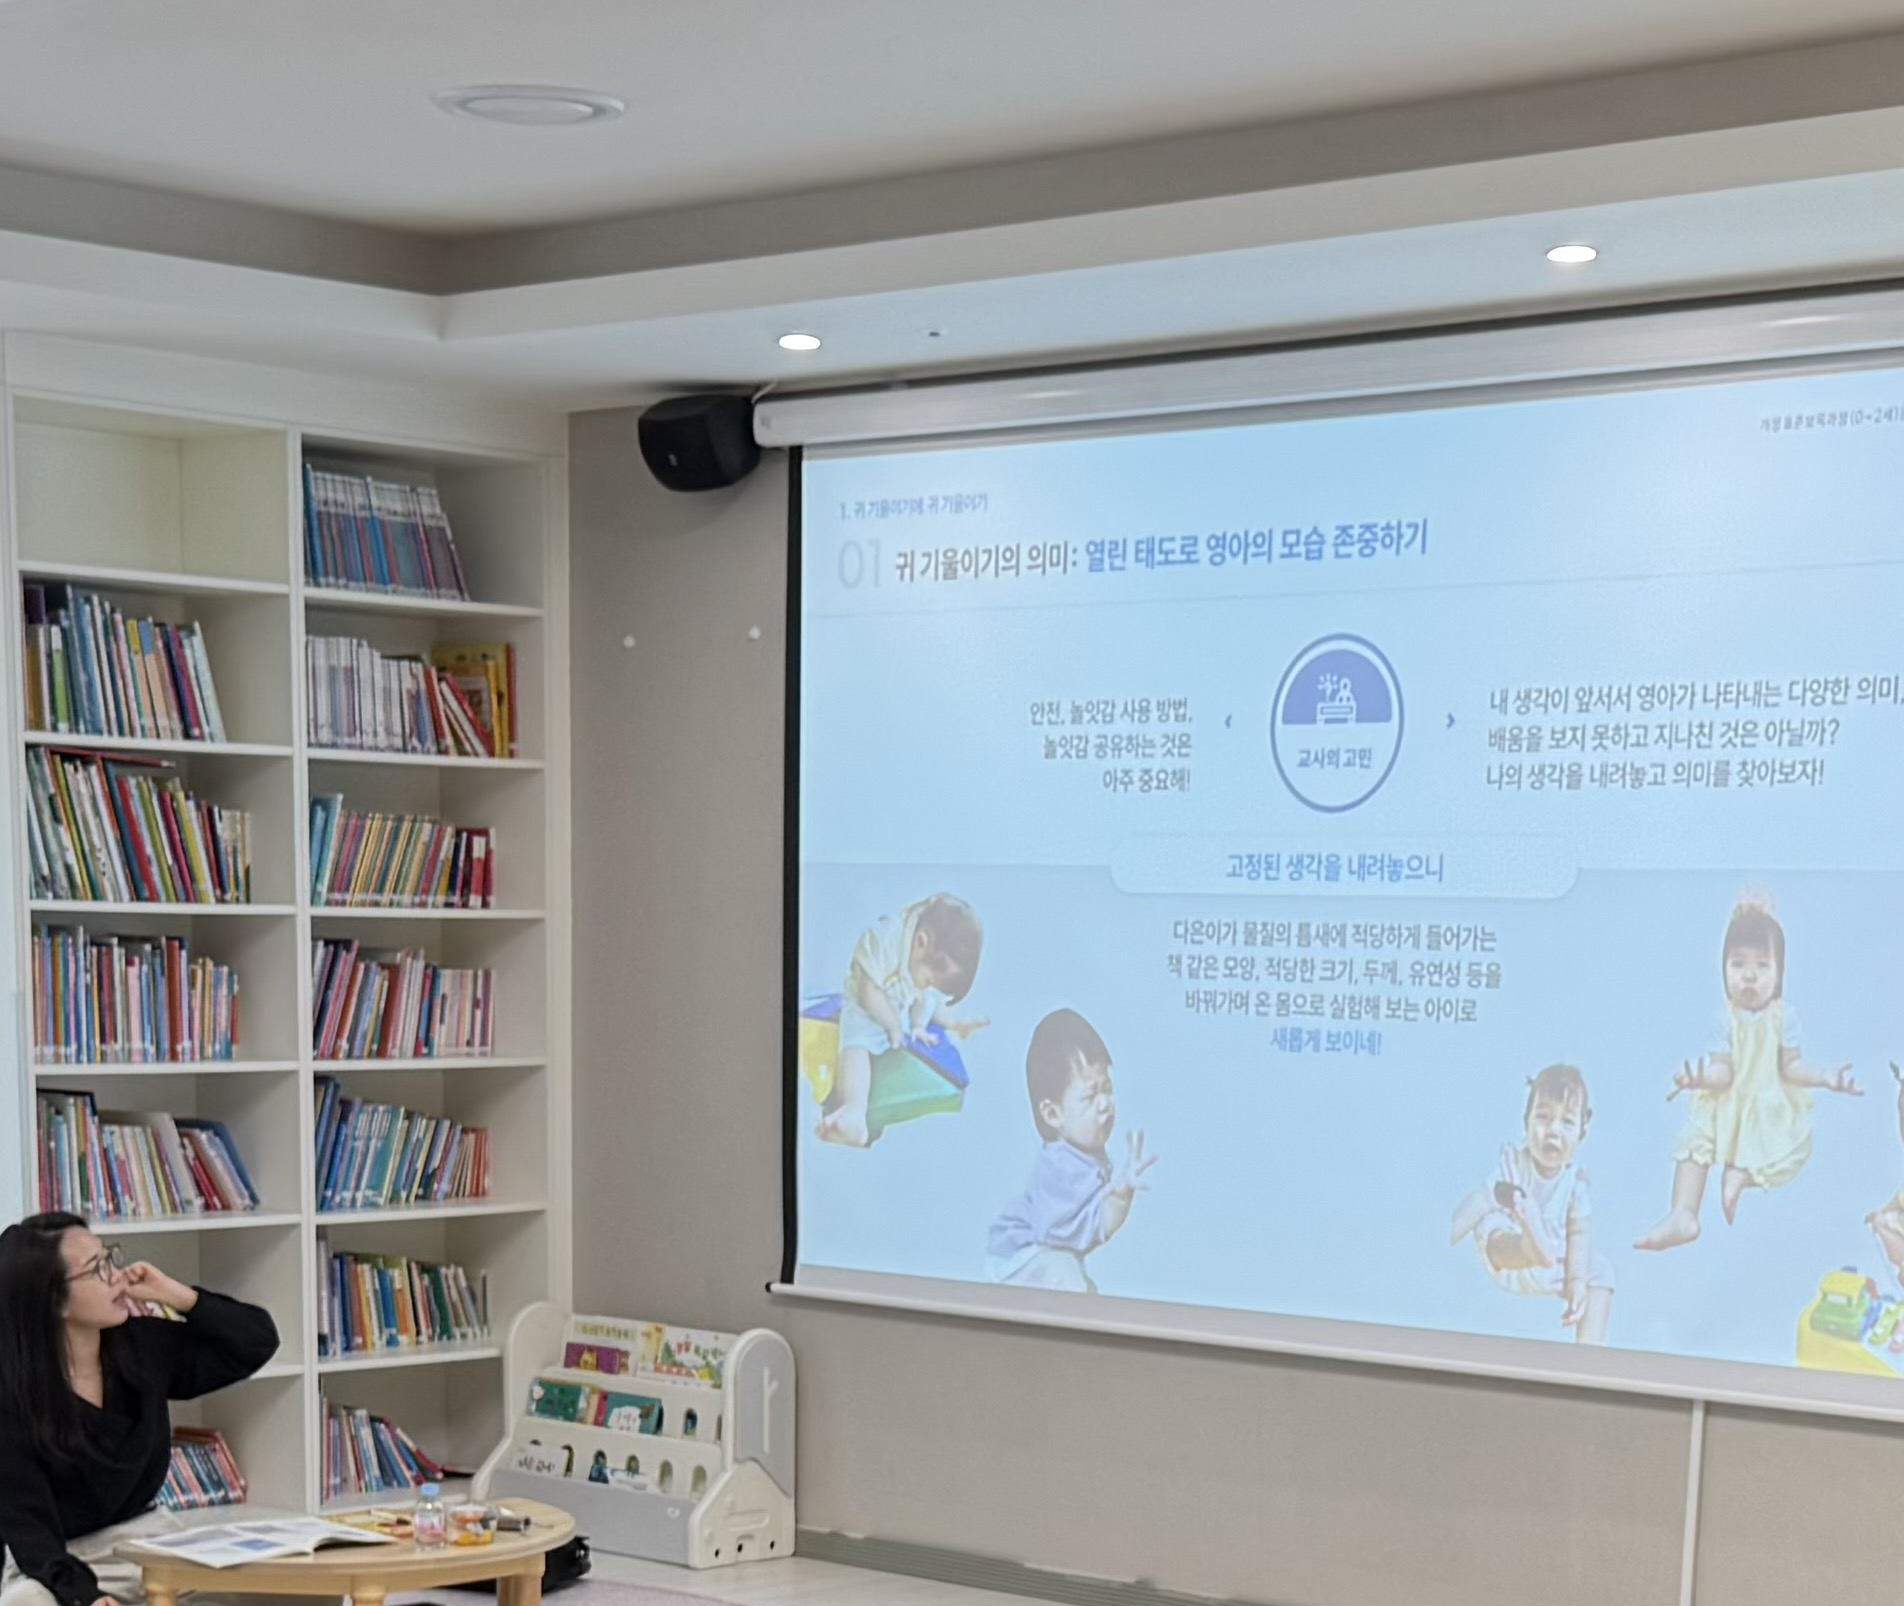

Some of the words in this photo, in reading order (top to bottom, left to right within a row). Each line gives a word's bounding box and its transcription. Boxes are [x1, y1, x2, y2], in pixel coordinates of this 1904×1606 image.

[837, 538, 881, 589] 01
[896, 549, 915, 583] 귀
[920, 543, 1021, 581] 기울이기의
[1027, 541, 1078, 576] 의미:
[1085, 537, 1128, 574] 열린
[1134, 534, 1200, 570] 태도로
[1206, 527, 1273, 566] 영아의
[1279, 524, 1326, 562] 모습
[1331, 517, 1428, 559] 존중하기
[1030, 699, 1065, 726] 안전,
[1070, 699, 1115, 725] 놀잇감
[1119, 699, 1151, 725] 사용
[1156, 697, 1192, 724] 방법,
[1490, 688, 1508, 716] 내
[1514, 686, 1569, 715] 생각이
[1575, 683, 1631, 714] 앞서서
[1636, 682, 1695, 712] 영아가
[1702, 679, 1782, 711] 나타내는
[1788, 677, 1849, 707] 다양한
[1043, 734, 1089, 760] 놀잇감
[1094, 733, 1155, 759] 공유하는
[1160, 733, 1192, 759] 것은
[1488, 723, 1542, 754] 배움을
[1548, 722, 1586, 750] 보지
[1592, 721, 1649, 751] 못하고
[1654, 720, 1713, 750] 지나친
[1719, 719, 1759, 748] 것은
[1765, 718, 1840, 748] 아닐까?
[1298, 748, 1340, 768] 교사의
[1343, 748, 1372, 768] 고민
[1104, 769, 1133, 793] 아주
[1139, 769, 1191, 793] 중요해!
[1487, 762, 1522, 791] 나의
[1527, 761, 1583, 790] 생각을
[1590, 760, 1666, 789] 내려놓고
[1673, 759, 1731, 788] 의미를
[1737, 757, 1824, 787] 찾아보자!
[1225, 853, 1280, 881] 고정된
[1286, 854, 1341, 882] 생각을
[1348, 853, 1444, 883] 내려놓으니
[1351, 923, 1421, 950] 적당하게
[1426, 924, 1497, 952] 들어가는
[1186, 955, 1218, 980] 같은
[1222, 956, 1260, 982] 모양,
[1265, 957, 1315, 984] 적당한
[1319, 958, 1358, 985] 크기,
[1408, 960, 1460, 988] 유연성
[1466, 962, 1502, 988] 등을
[1276, 992, 1325, 1018] 몸으로
[1330, 994, 1380, 1020] 실험해
[1385, 996, 1419, 1021] 보는
[1425, 997, 1477, 1023] 아이로
[1270, 1027, 1321, 1053] 새롭게
[1325, 1029, 1382, 1056] 보이네!
